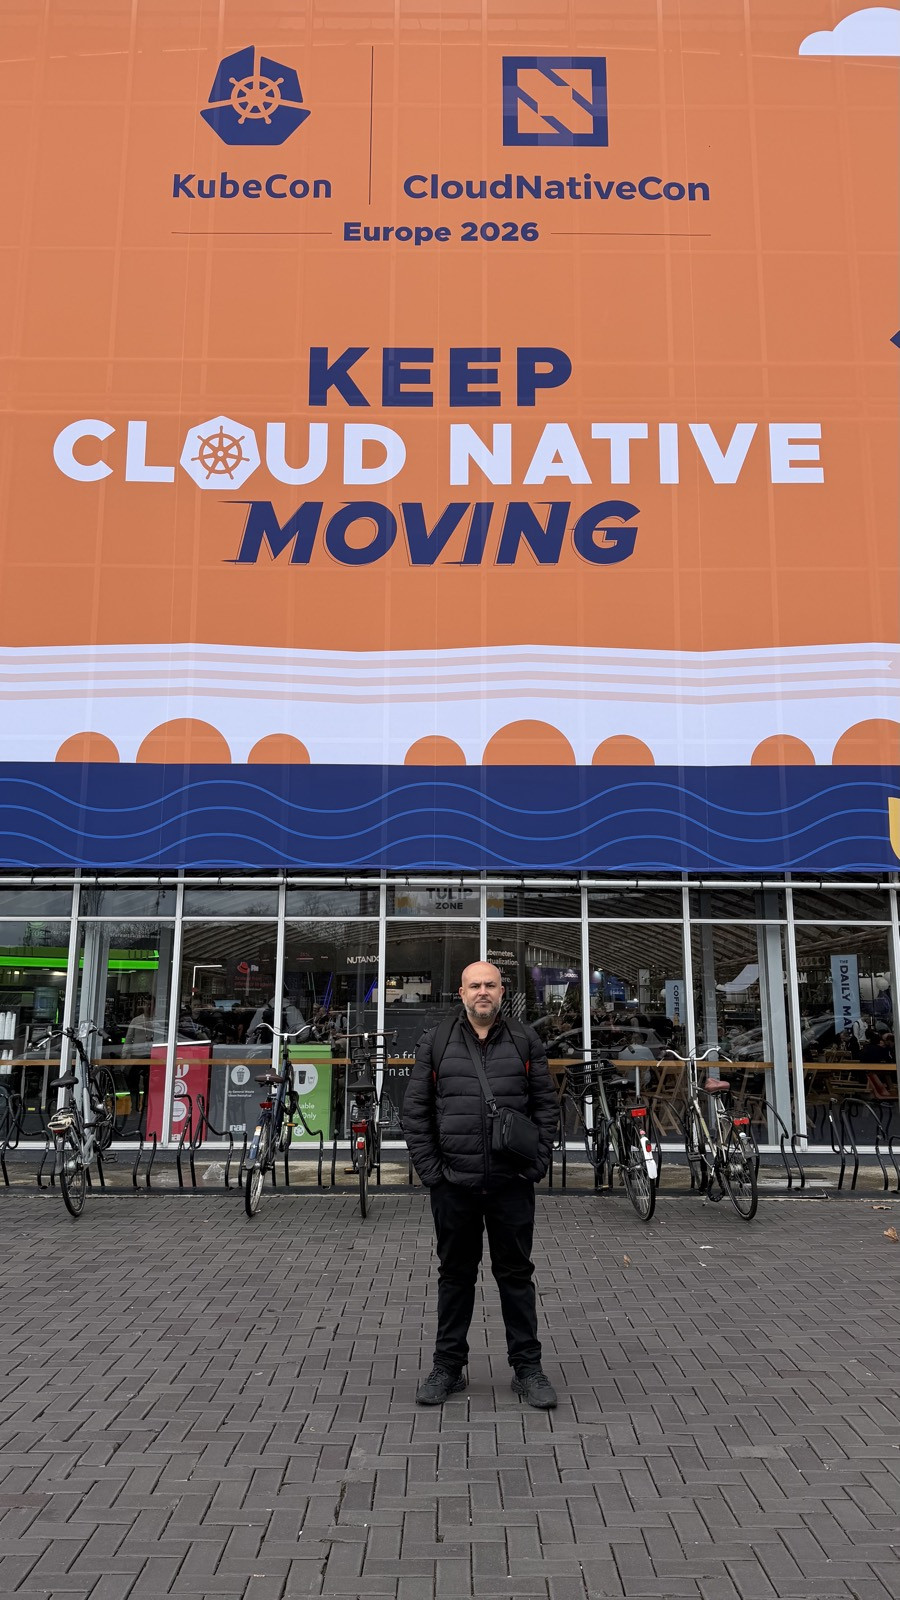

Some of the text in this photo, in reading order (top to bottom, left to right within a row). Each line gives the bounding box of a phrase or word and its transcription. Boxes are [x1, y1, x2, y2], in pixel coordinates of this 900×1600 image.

[172, 172, 331, 199] KubeCon
[403, 173, 710, 201] CloudNativeCon
[343, 222, 539, 246] Europe 2026
[308, 347, 572, 407] KEEP
[449, 422, 825, 486] NATIVE
[226, 500, 641, 566] MOVING
[426, 887, 473, 900] TULIP
[435, 902, 464, 910] ZONE
[346, 955, 379, 965] NUTANIX
[487, 948, 515, 957] ubernetes.
[840, 965, 851, 1002] DAILY
[398, 1066, 410, 1077] at
[302, 1112, 317, 1121] Only
[229, 1123, 246, 1132] rai
